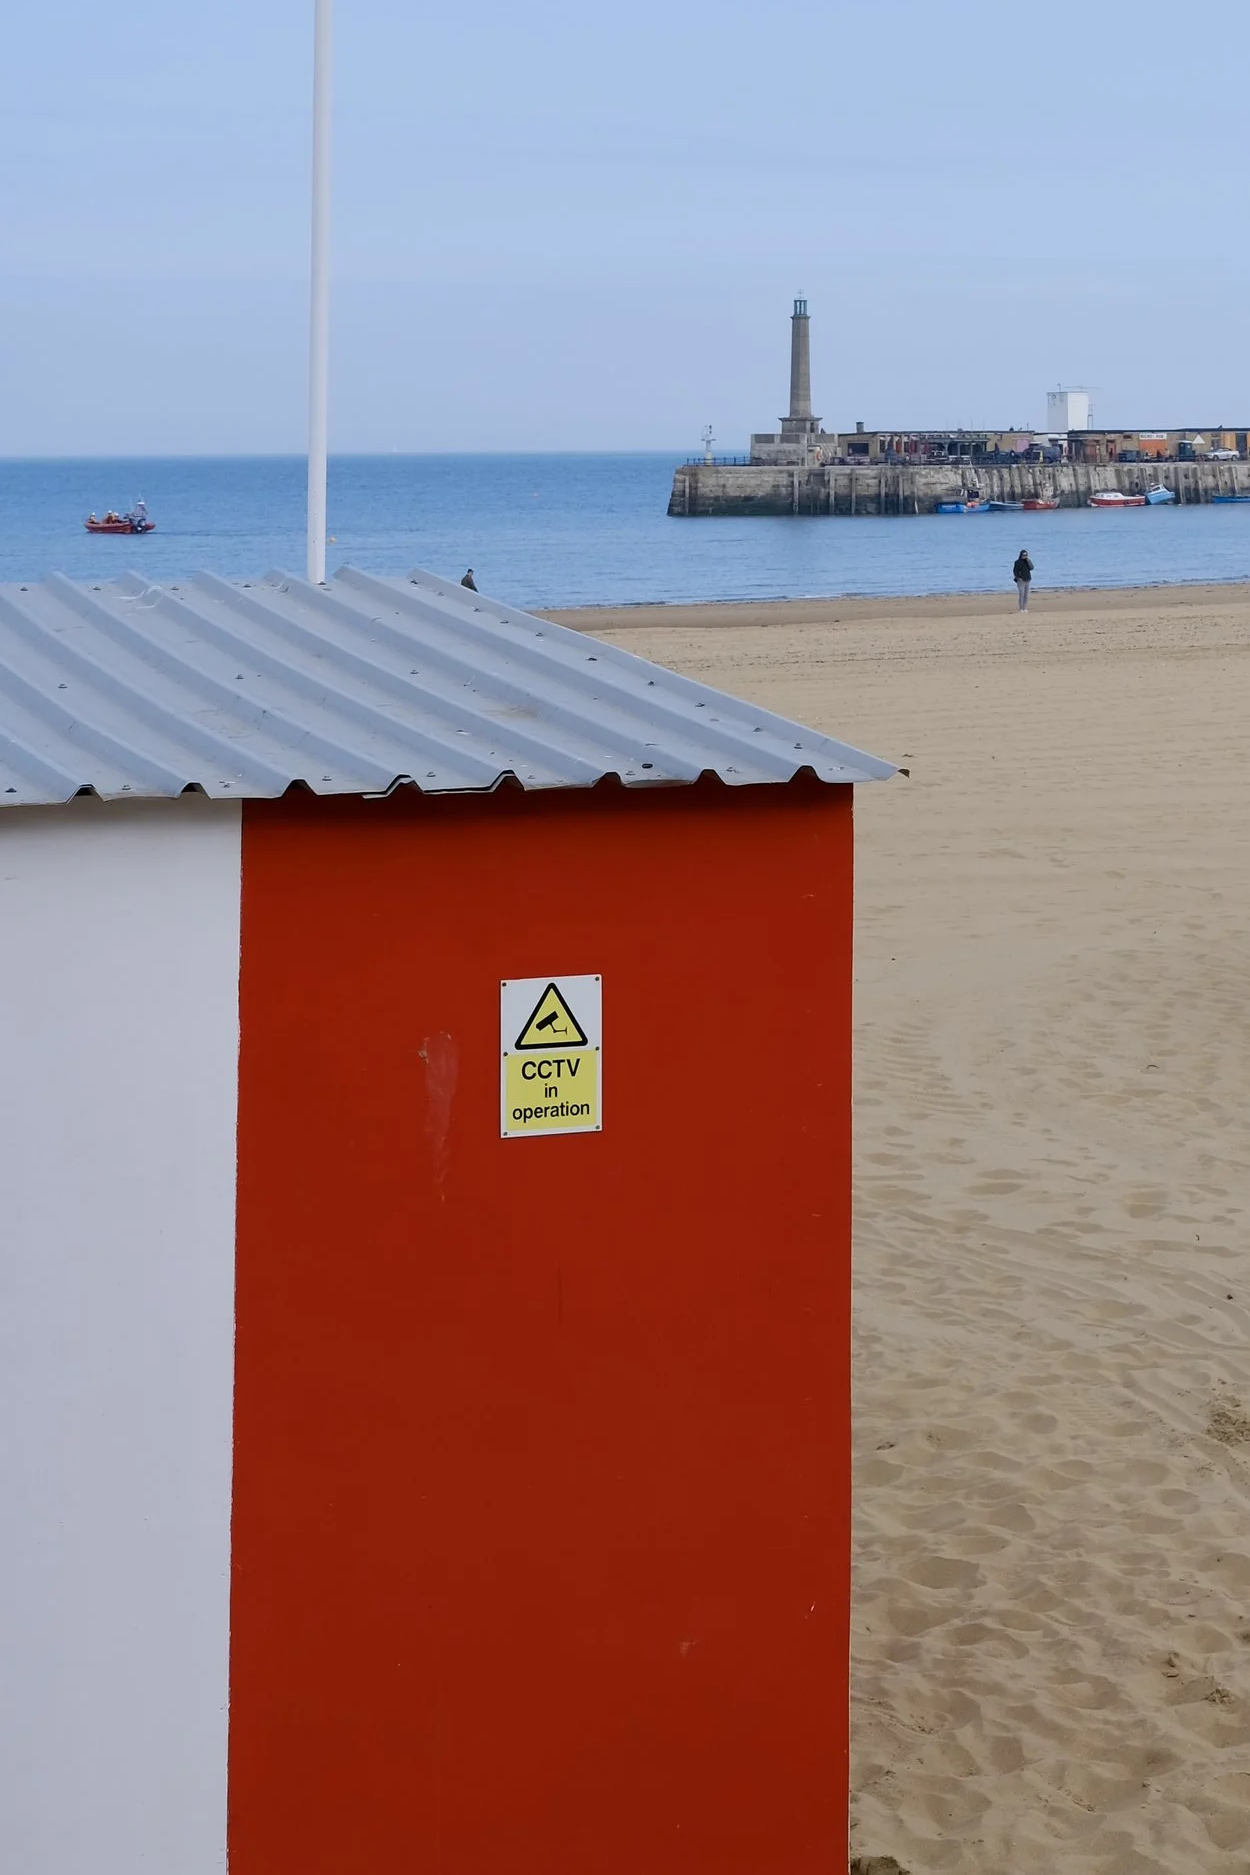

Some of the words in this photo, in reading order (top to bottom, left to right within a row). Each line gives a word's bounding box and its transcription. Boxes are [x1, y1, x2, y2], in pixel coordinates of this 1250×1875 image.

[521, 1058, 581, 1081] CCTV
[544, 1083, 558, 1098] in
[512, 1101, 590, 1123] operation
